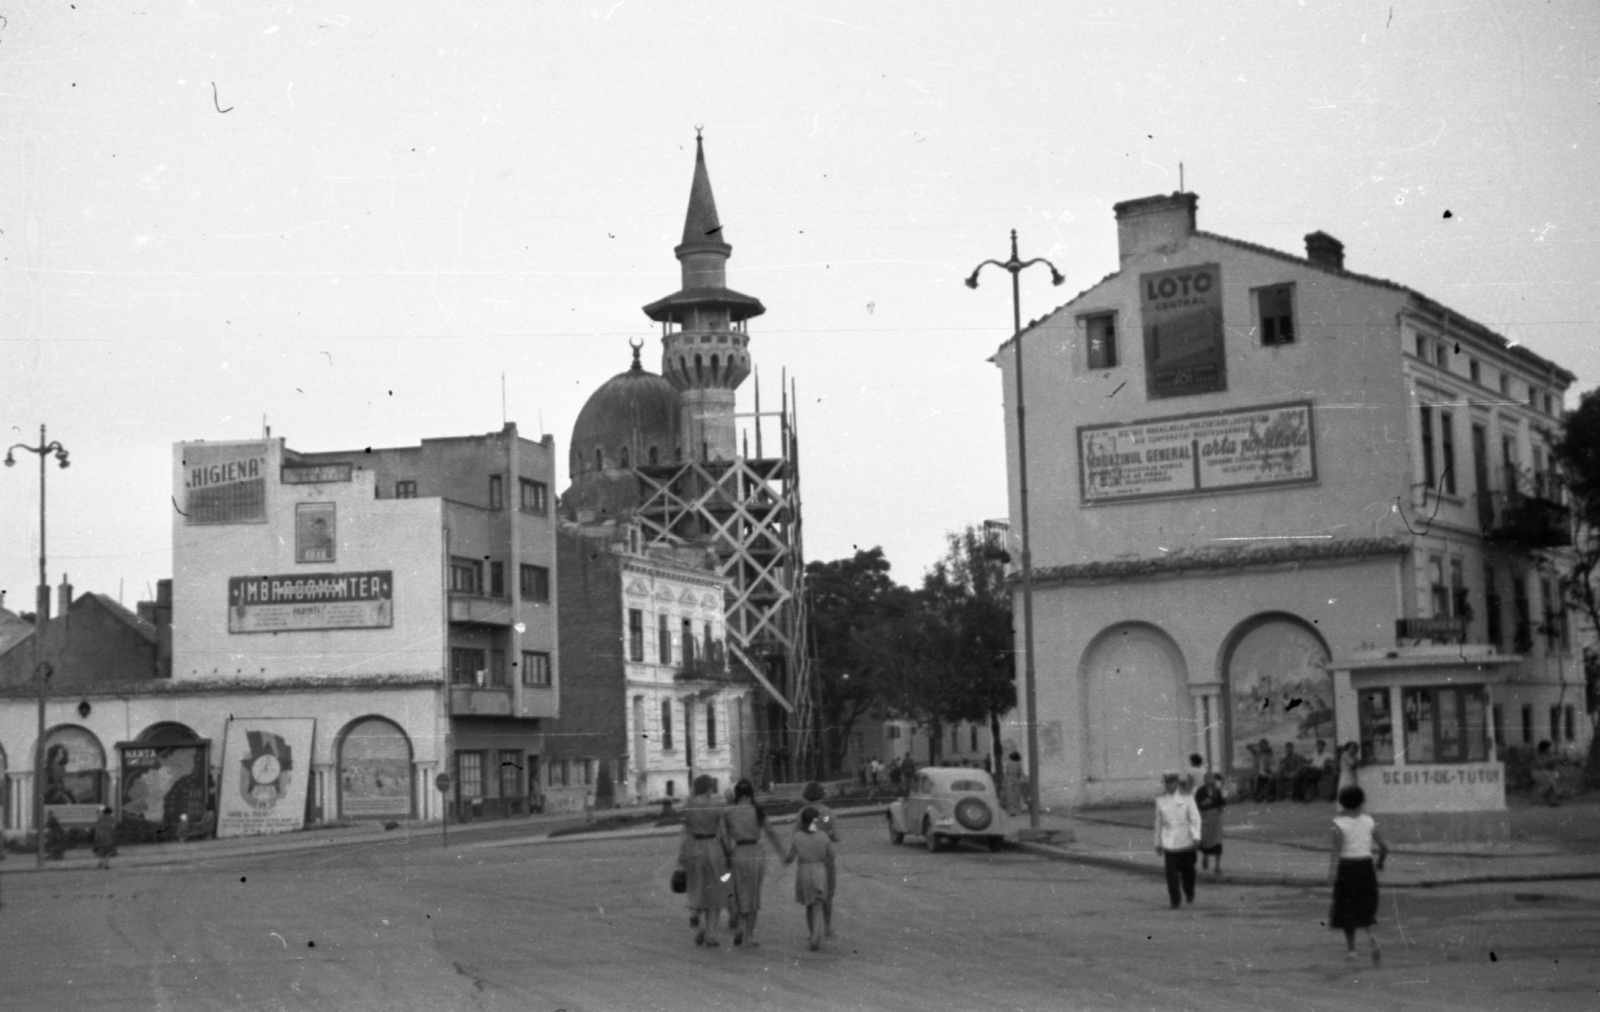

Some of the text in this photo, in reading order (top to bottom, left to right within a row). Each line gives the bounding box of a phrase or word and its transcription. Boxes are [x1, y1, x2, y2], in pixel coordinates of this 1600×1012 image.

[1147, 272, 1212, 300] LOTO
[1155, 297, 1206, 310] CENTRAL
[1146, 446, 1191, 463] GENERAL
[1202, 435, 1237, 457] arta
